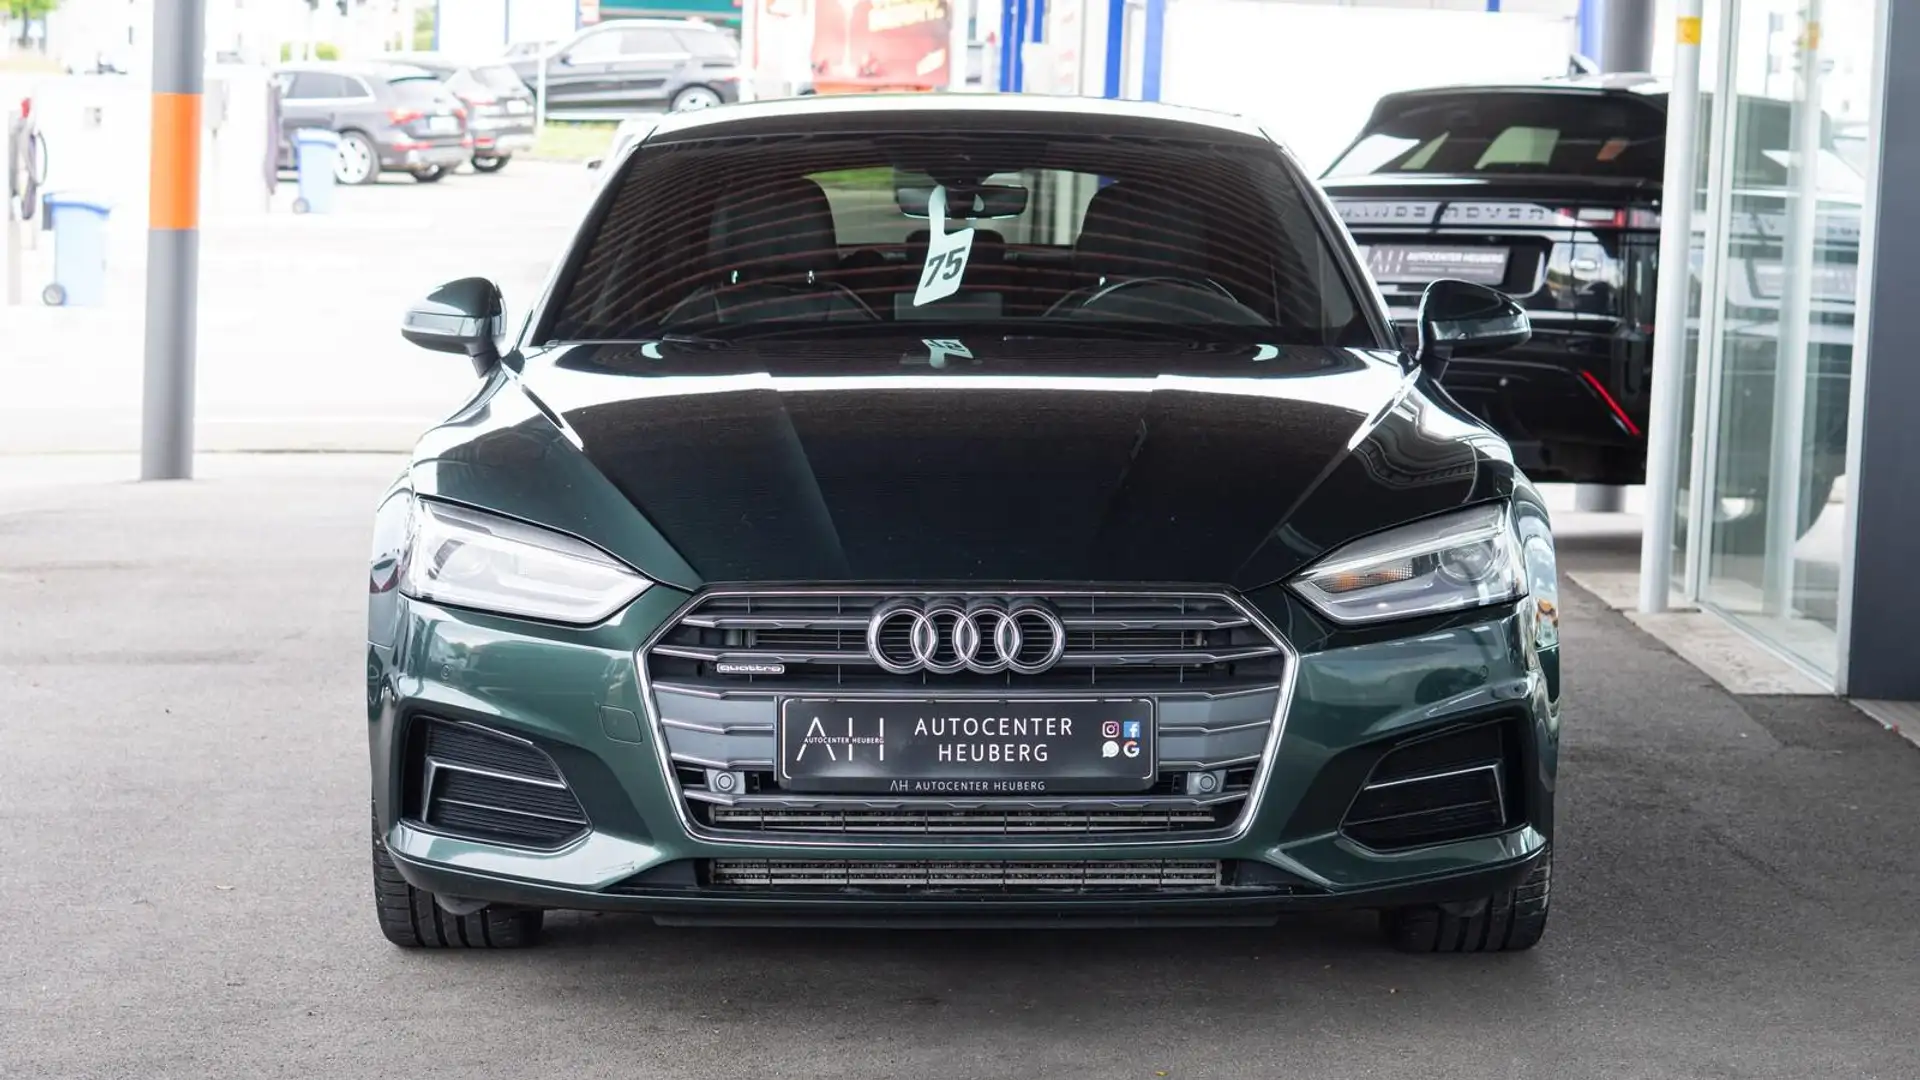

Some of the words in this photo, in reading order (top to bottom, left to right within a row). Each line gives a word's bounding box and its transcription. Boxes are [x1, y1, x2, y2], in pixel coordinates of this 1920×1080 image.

[924, 246, 967, 288] 75
[719, 664, 782, 673] quattro
[914, 717, 1073, 736] AUTOCENTER
[796, 717, 885, 761] AH
[804, 736, 850, 744] AUTOCENTER
[852, 736, 885, 744] HEUBERG
[938, 743, 1049, 762] HEUBERG
[890, 779, 909, 792] AH
[915, 781, 989, 791] AUTOCENTER
[993, 781, 1046, 791] HEUBERG
